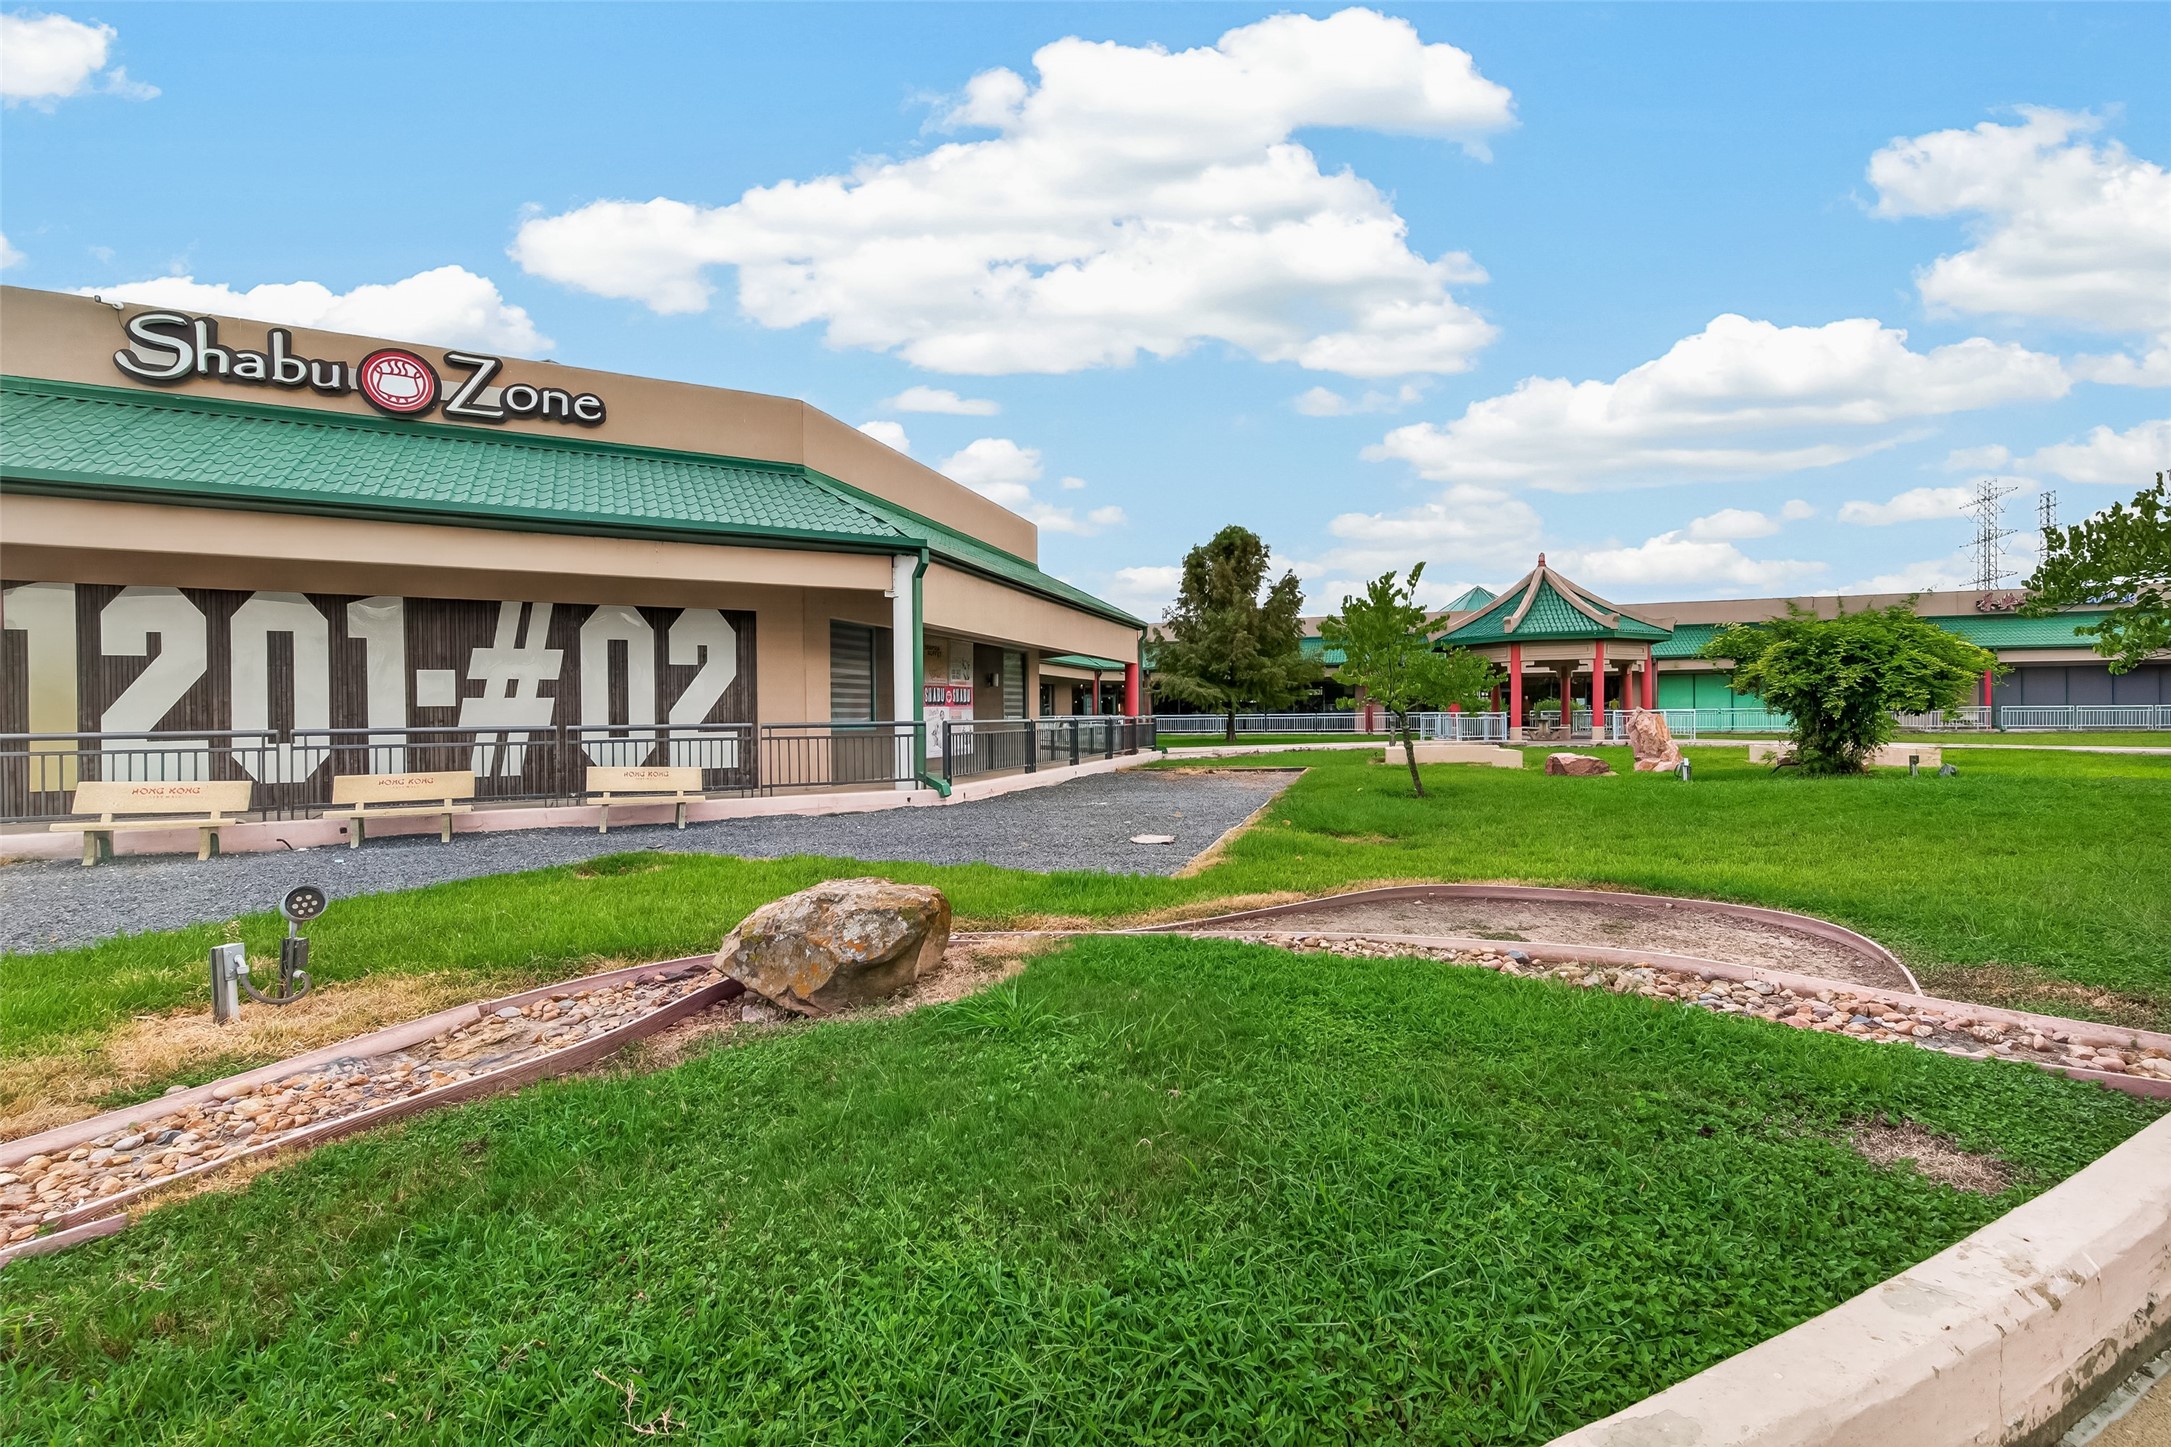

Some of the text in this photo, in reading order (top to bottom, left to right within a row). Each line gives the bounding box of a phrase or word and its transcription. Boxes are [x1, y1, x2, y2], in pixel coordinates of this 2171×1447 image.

[113, 311, 605, 422] Shabu Zone
[623, 770, 670, 778] HONG KONG
[378, 777, 434, 786] HONG KONG
[131, 787, 201, 795] HONG KONG
